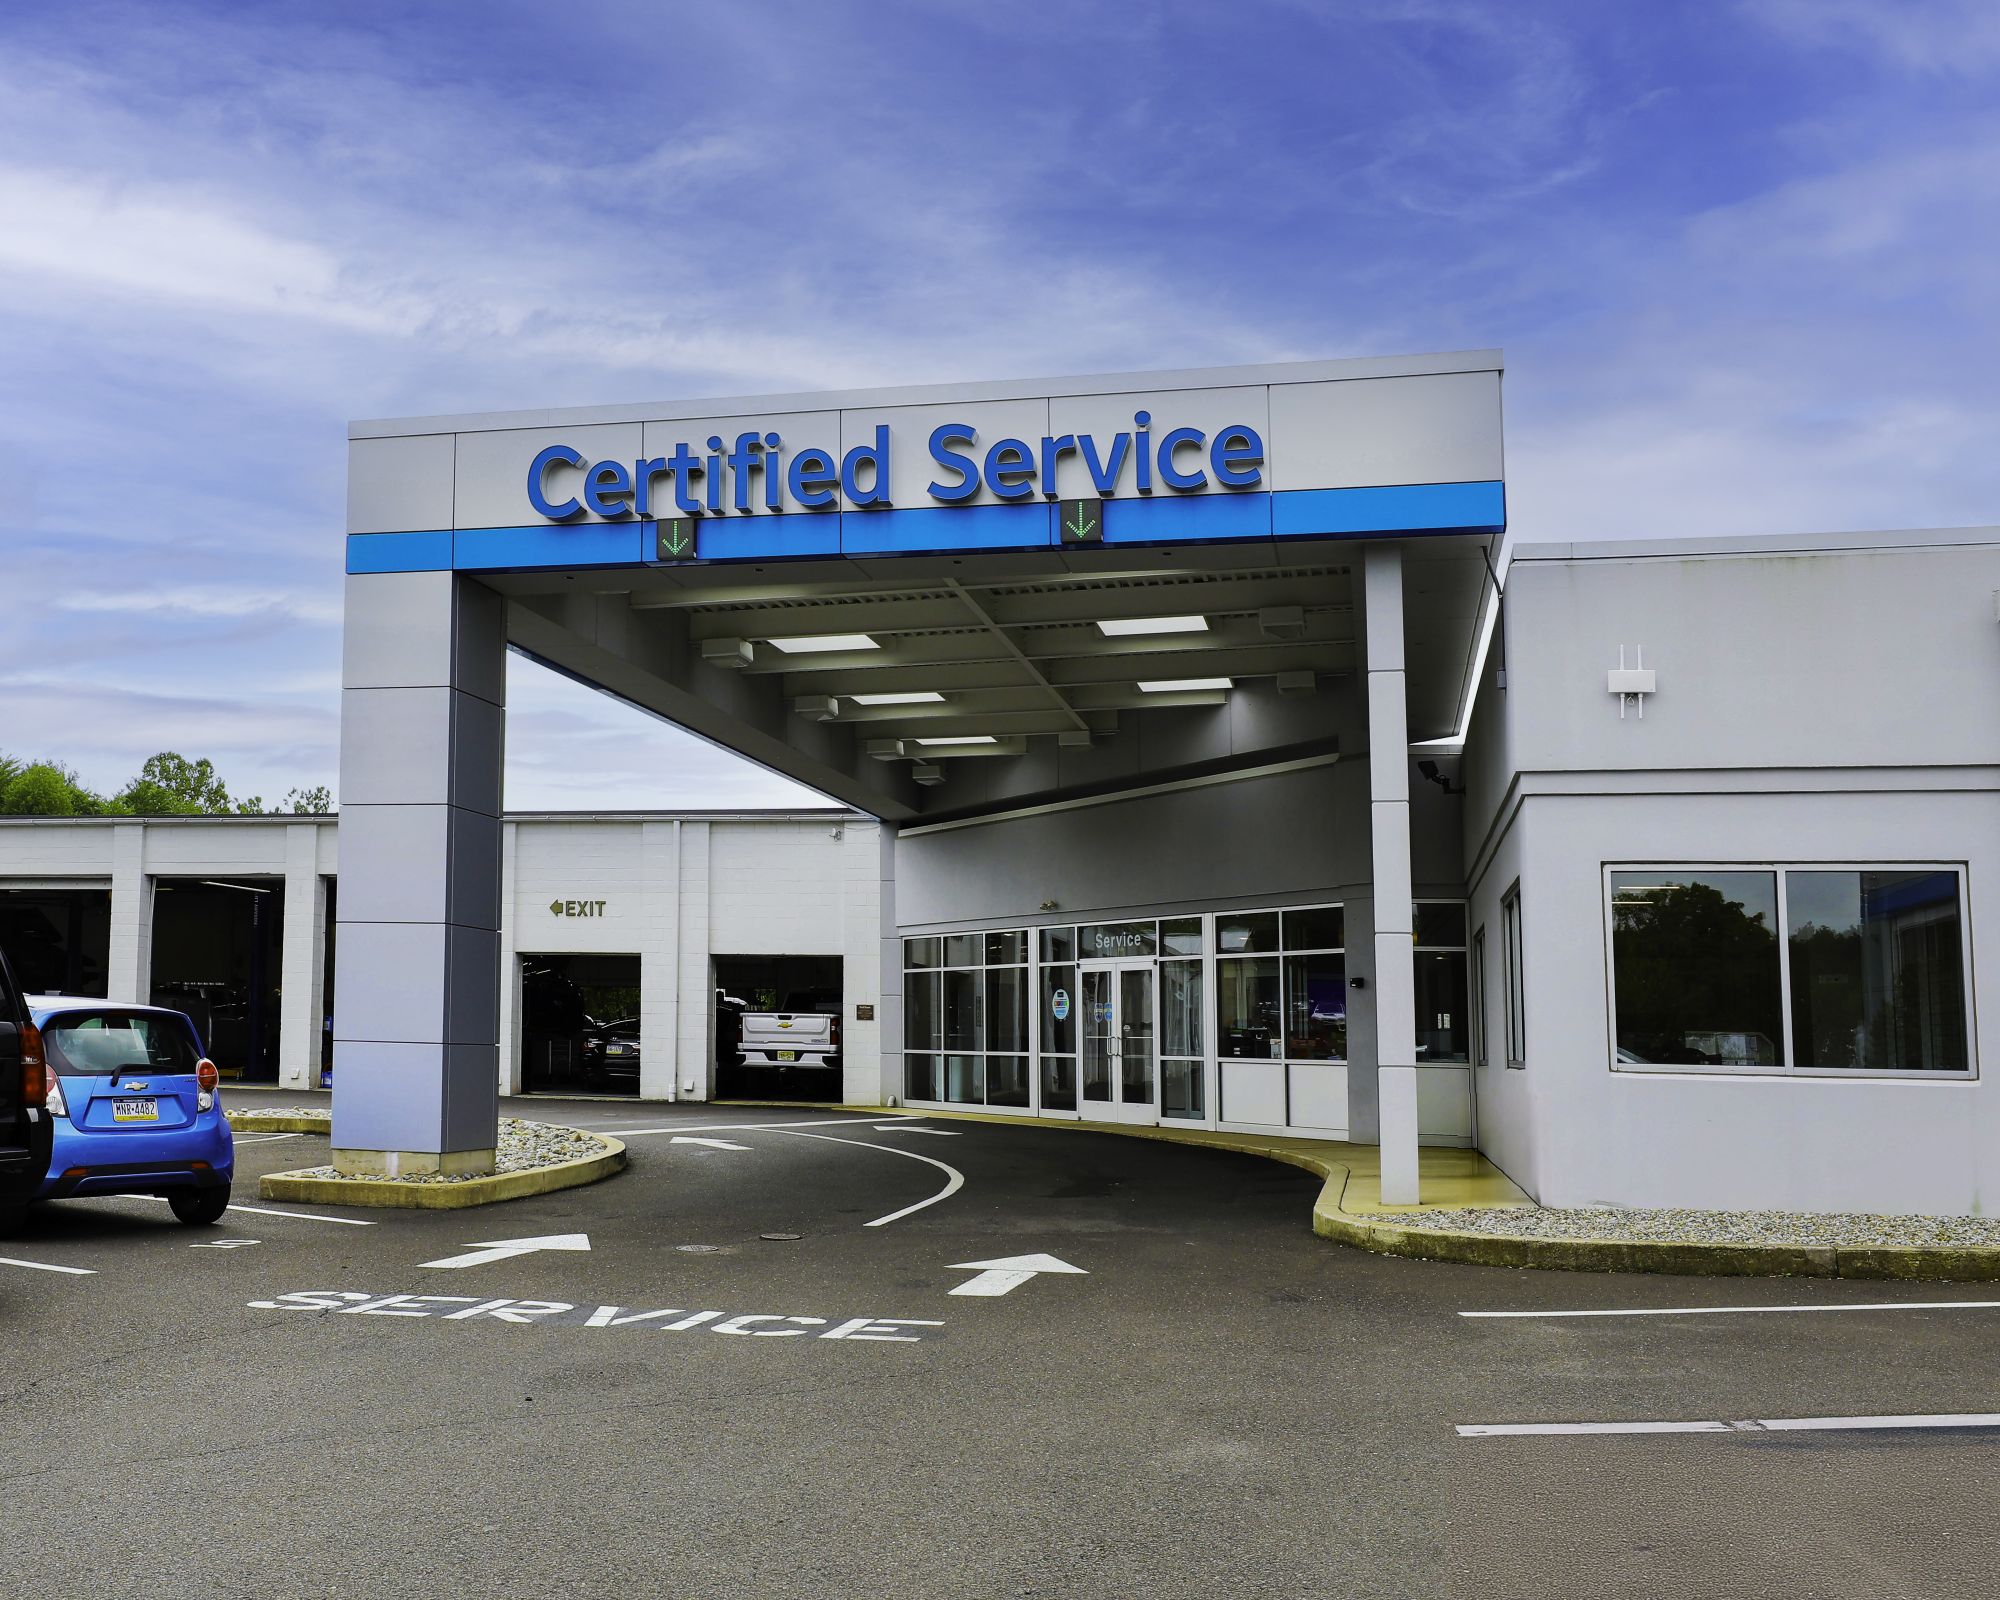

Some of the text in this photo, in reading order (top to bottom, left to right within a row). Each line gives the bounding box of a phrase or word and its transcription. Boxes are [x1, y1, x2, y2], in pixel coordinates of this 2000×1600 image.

[527, 410, 1265, 523] Certified Service
[565, 900, 606, 917] EXIT
[1095, 931, 1141, 949] Service
[246, 1290, 946, 1342] SERVICE
